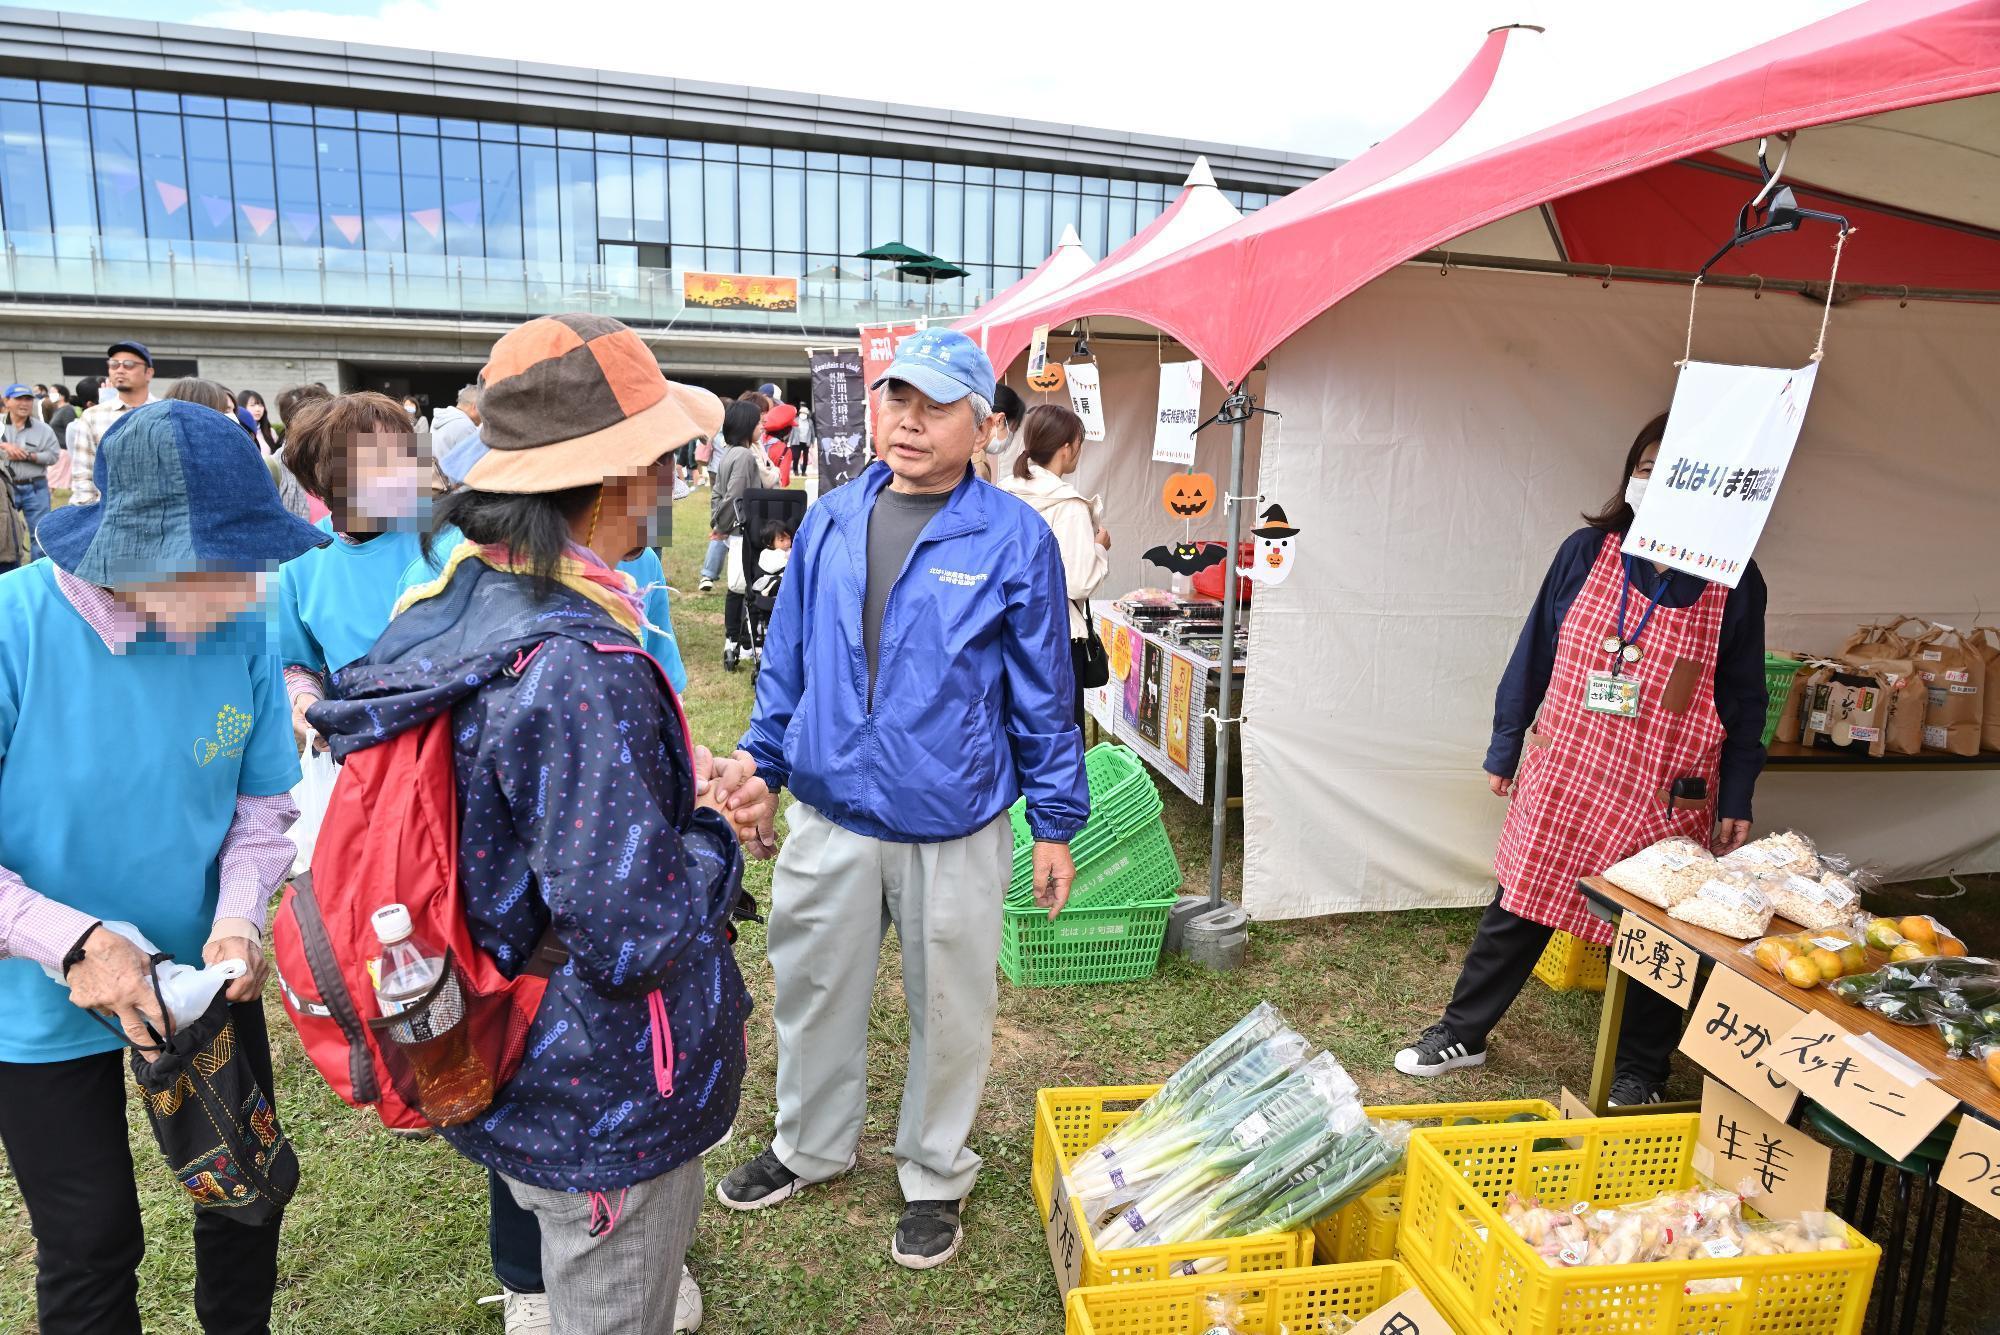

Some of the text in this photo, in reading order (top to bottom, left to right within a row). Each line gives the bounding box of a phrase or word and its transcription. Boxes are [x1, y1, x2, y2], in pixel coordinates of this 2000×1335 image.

[1665, 457, 1780, 502] 北はりま旬菜館
[615, 824, 642, 881] OUTDOOR
[611, 940, 636, 986] OUTDOOR
[1618, 929, 1688, 990] ポン菓子
[531, 1020, 569, 1060] OUTDOOR
[697, 1059, 722, 1109] OUTDOOR
[1779, 1034, 1907, 1118] ズッキーニ
[1717, 1114, 1794, 1194] 生姜
